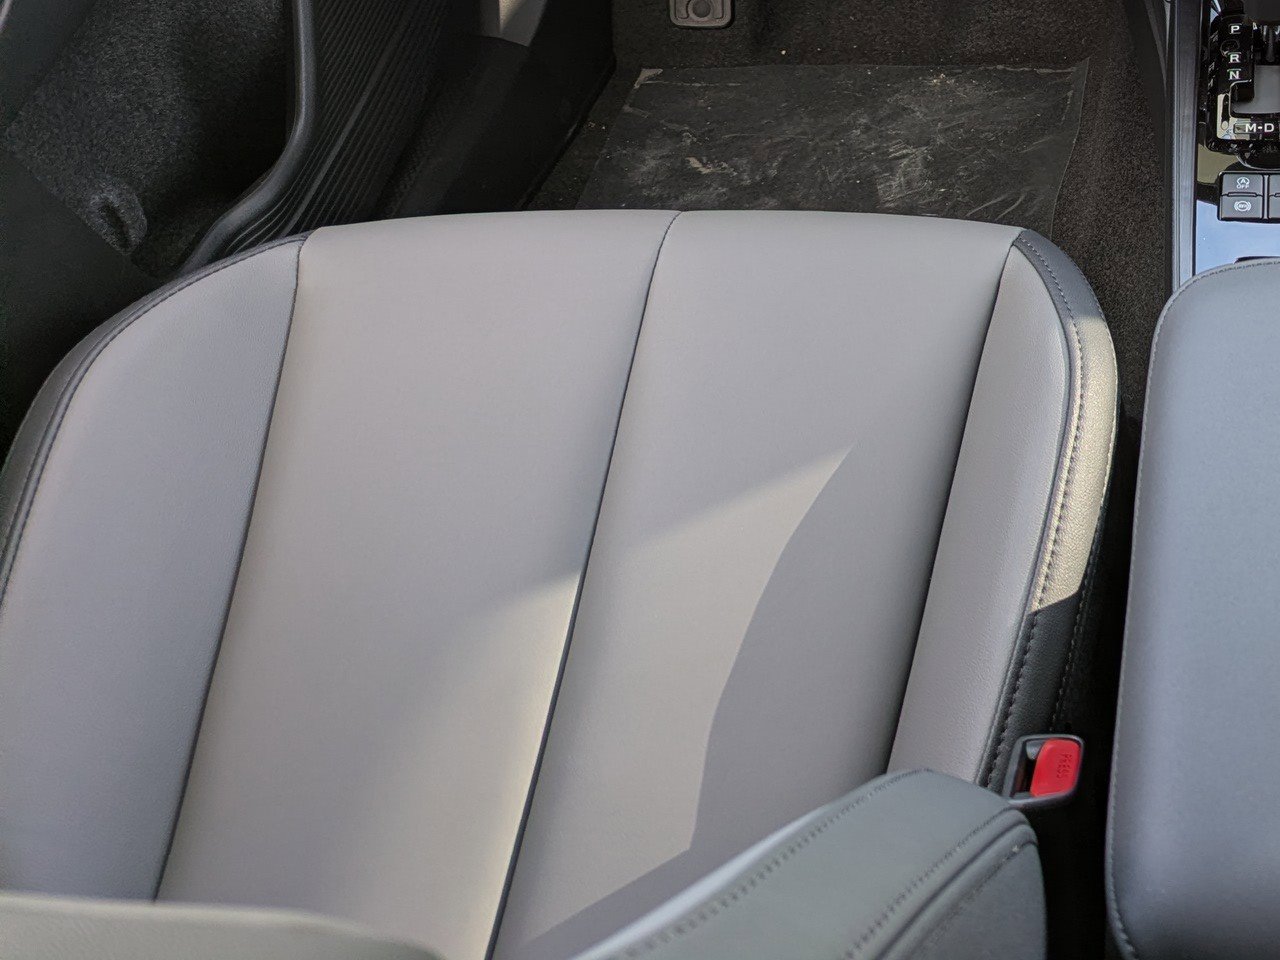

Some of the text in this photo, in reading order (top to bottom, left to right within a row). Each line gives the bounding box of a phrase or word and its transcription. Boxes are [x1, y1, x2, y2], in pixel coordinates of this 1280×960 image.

[1230, 25, 1240, 34] P
[1230, 54, 1240, 63] R
[1229, 70, 1239, 80] N
